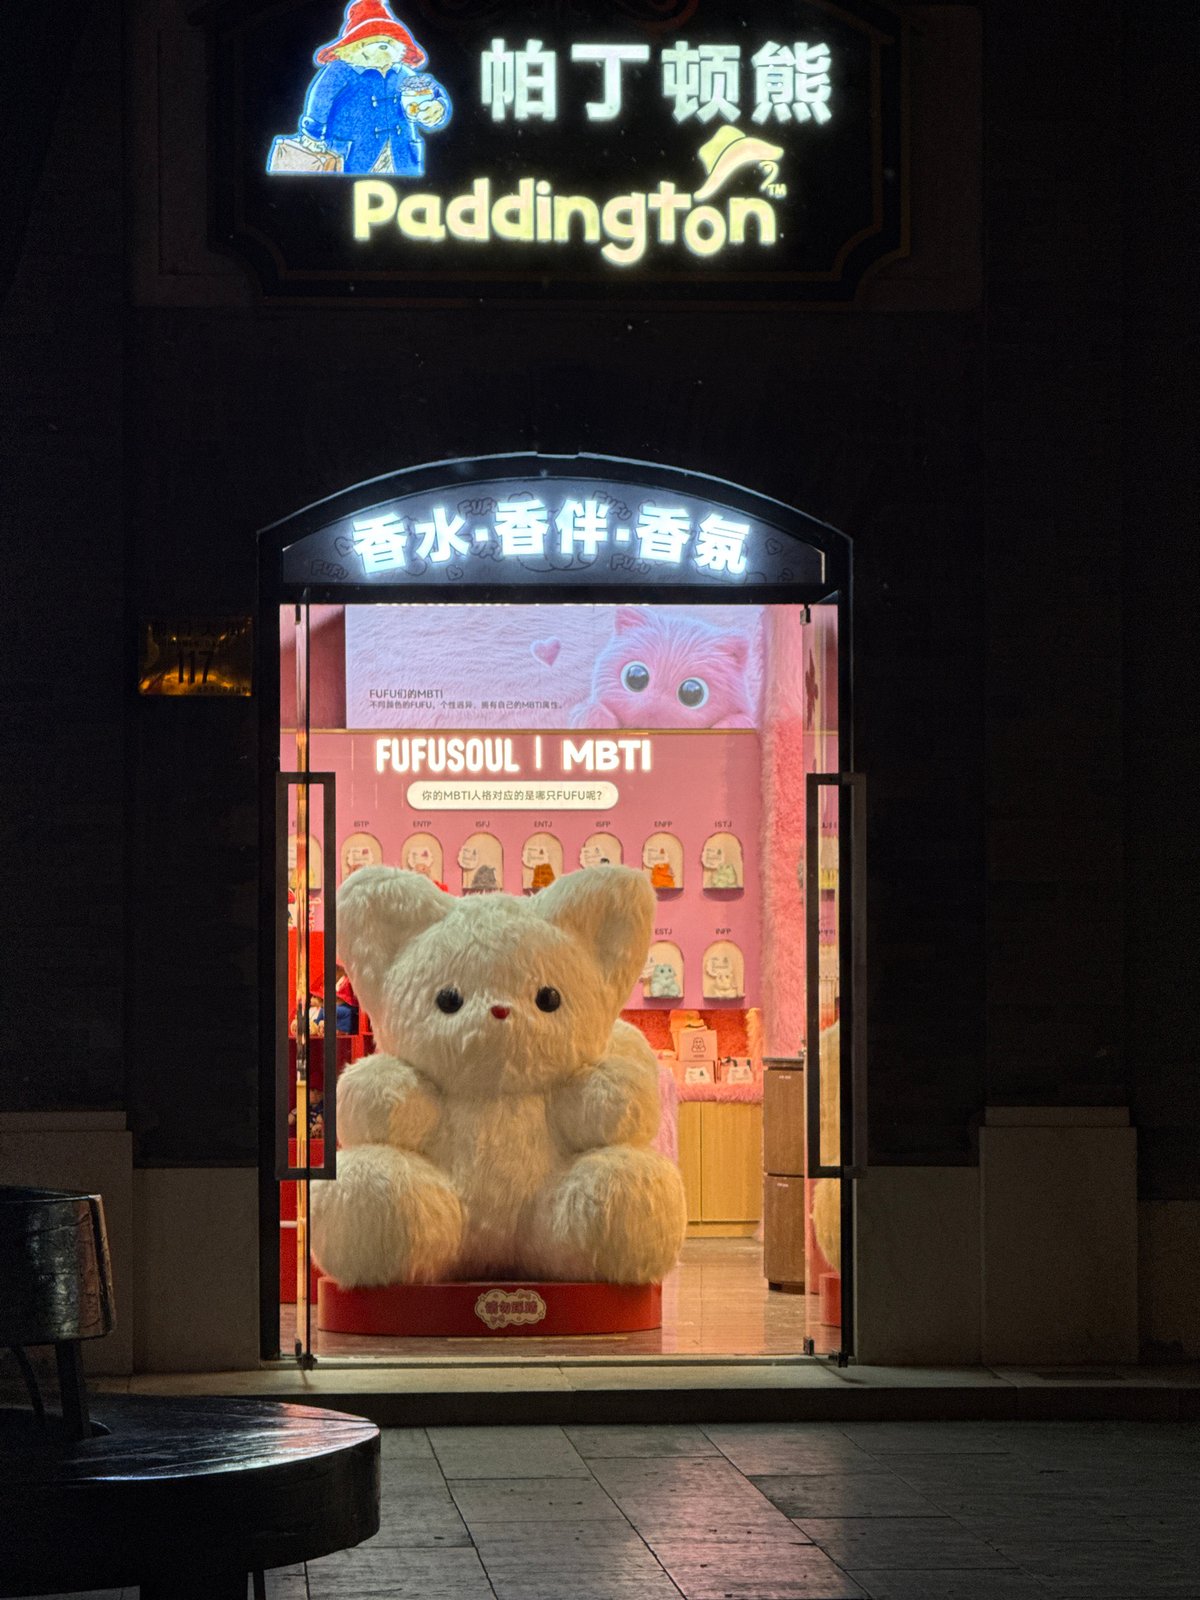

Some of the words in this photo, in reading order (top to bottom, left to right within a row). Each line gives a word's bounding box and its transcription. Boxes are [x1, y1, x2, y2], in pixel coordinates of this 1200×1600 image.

[481, 38, 832, 124] 帕丁顿熊
[353, 177, 777, 266] Paddington
[177, 650, 214, 683] 117
[369, 688, 443, 699] FUFU们的MBTI
[376, 737, 520, 773] FUFUSOUL
[562, 739, 652, 771] MBTI
[714, 820, 732, 828] ISTJ
